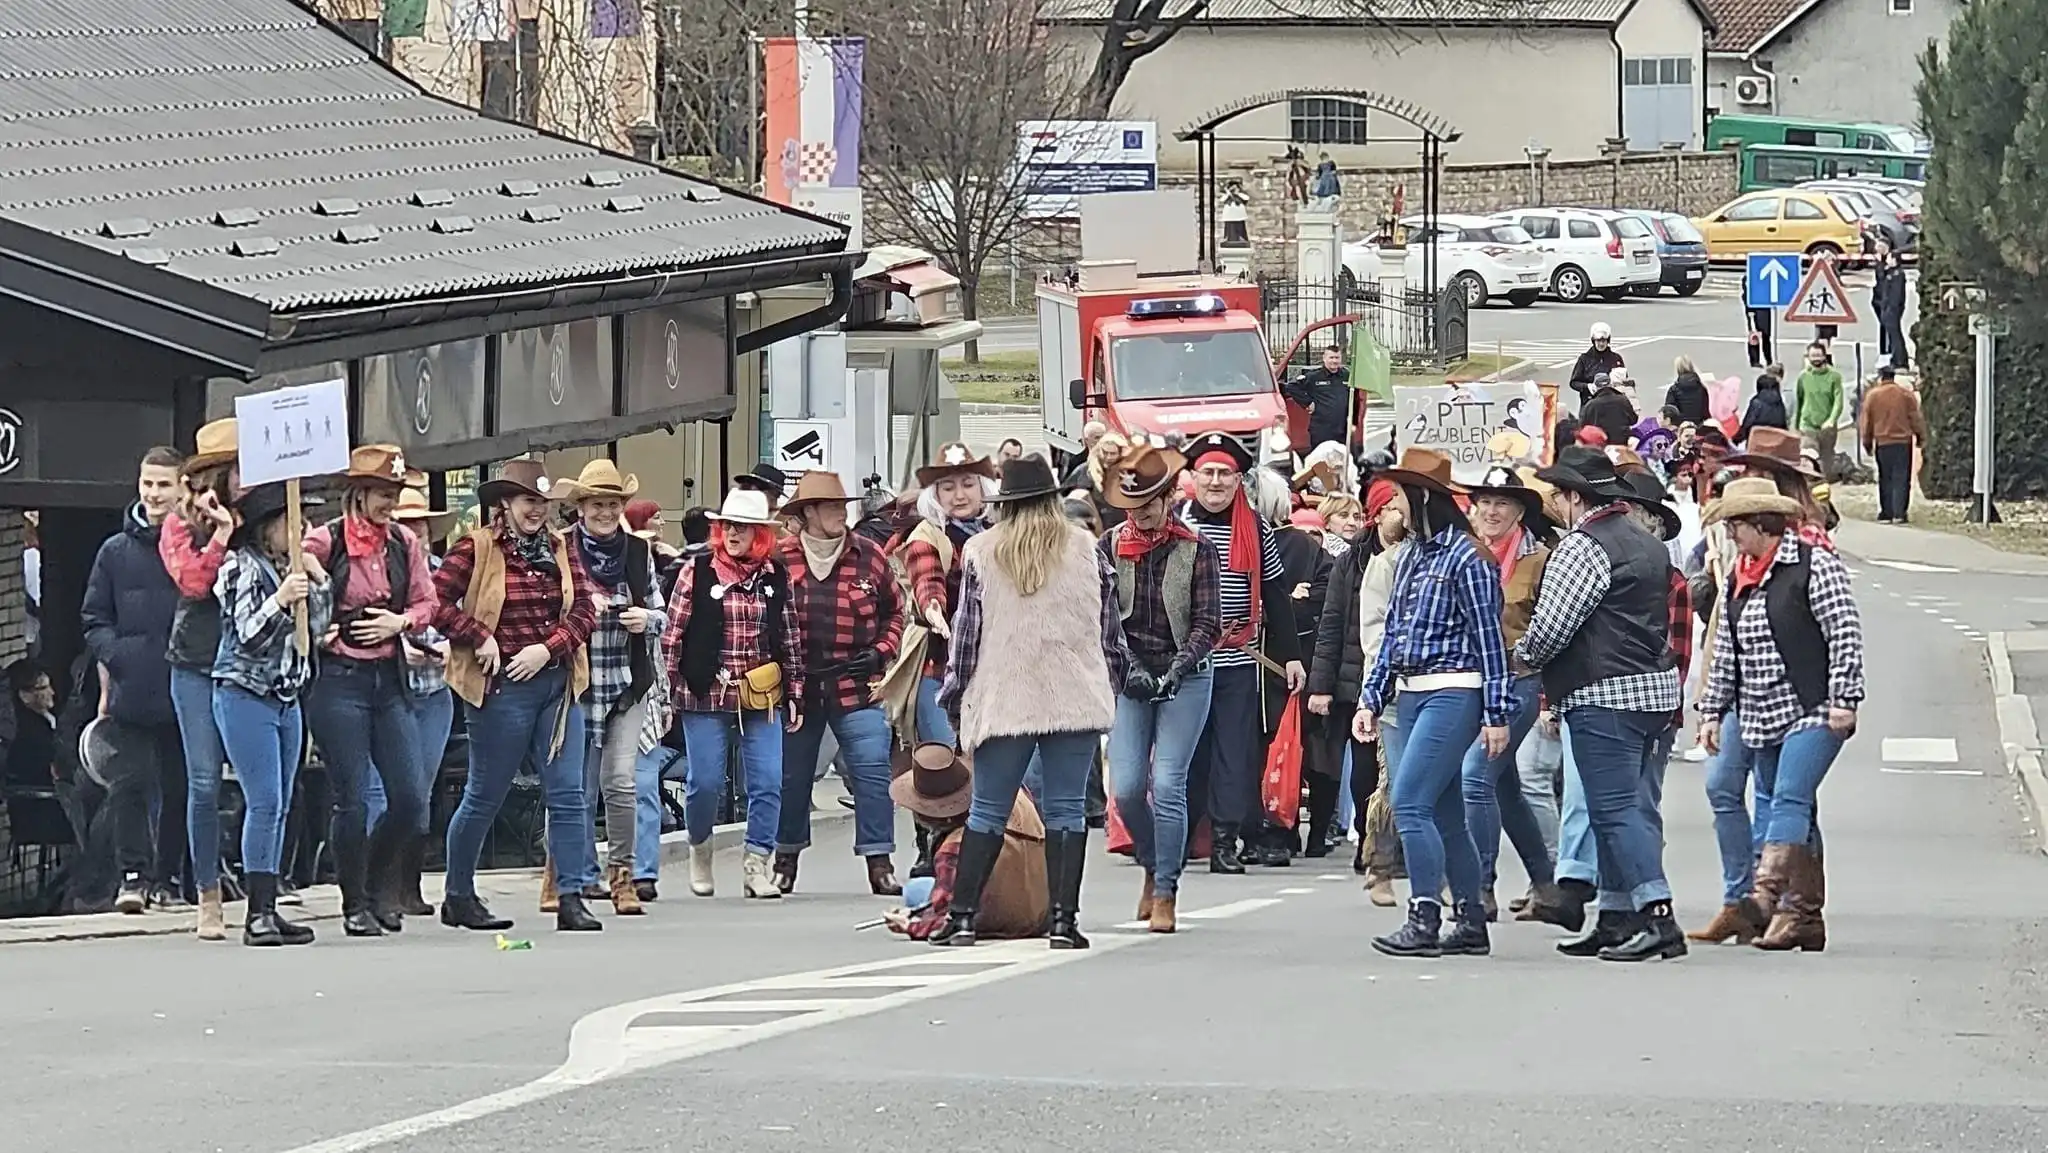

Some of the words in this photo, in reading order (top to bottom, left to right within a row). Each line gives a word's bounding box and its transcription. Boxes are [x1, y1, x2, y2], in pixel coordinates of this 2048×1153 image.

[1184, 342, 1194, 352] 2
[1438, 402, 1495, 426] PTT
[1413, 425, 1507, 444] ZGUBLEN
